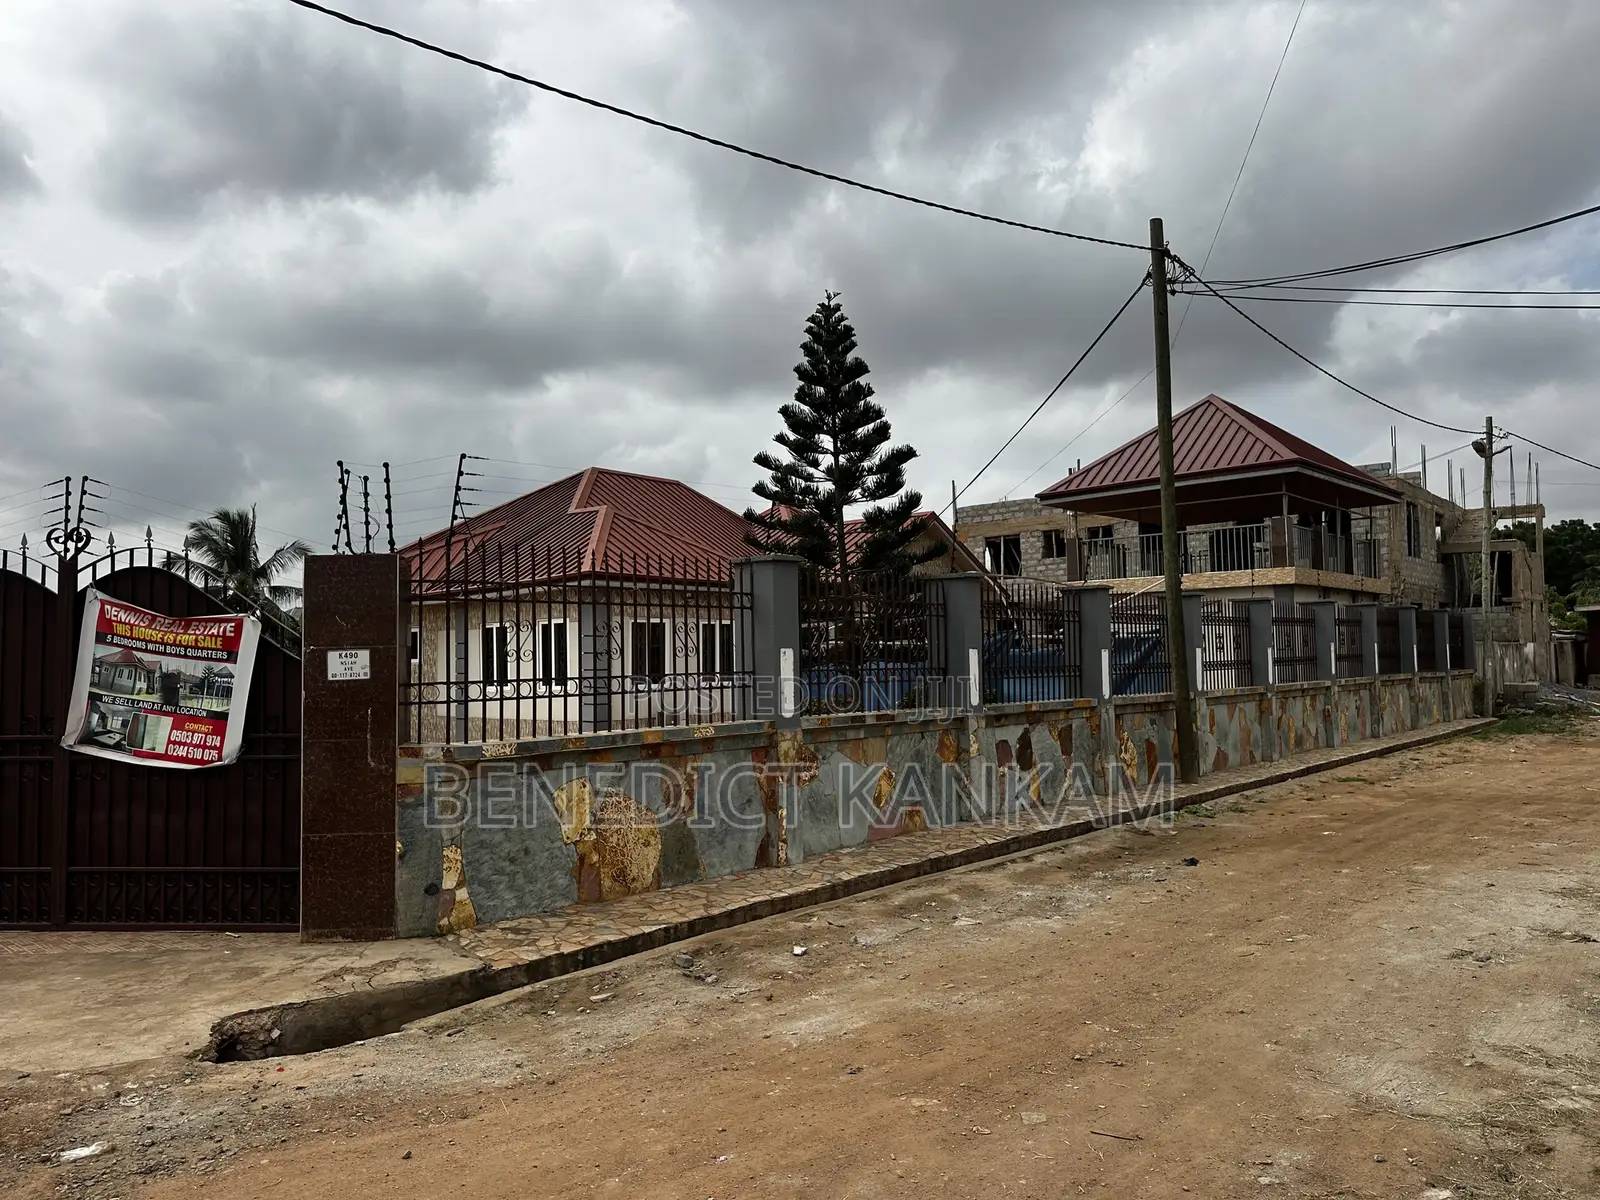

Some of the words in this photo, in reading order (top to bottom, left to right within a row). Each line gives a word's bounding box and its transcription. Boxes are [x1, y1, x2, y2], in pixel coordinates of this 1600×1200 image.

[104, 605, 151, 627] DENNIS
[152, 616, 185, 634] REAL
[187, 621, 235, 637] ESTATE
[112, 622, 131, 637] THIS
[132, 626, 162, 642] HOUSE
[164, 633, 175, 644] IS
[176, 634, 196, 646] FOR
[197, 636, 223, 649] SALE
[106, 634, 112, 643] 5
[113, 635, 146, 650] BEDROOMS
[147, 643, 165, 653] WITH
[166, 645, 185, 655] BOYS
[186, 648, 228, 660] QUARTERS
[338, 651, 359, 659] K490
[101, 695, 114, 705] WE
[114, 697, 133, 707] SELL
[134, 700, 152, 710] LAND
[153, 703, 162, 711] AT
[162, 705, 176, 713] ANY
[176, 706, 207, 718] LOCATION
[184, 722, 214, 733] CONTACT
[170, 729, 192, 743] 0503
[192, 731, 206, 745] 977
[206, 734, 221, 747] 974
[167, 744, 189, 758] 0244
[189, 745, 202, 760] 510
[203, 748, 219, 762] 075
